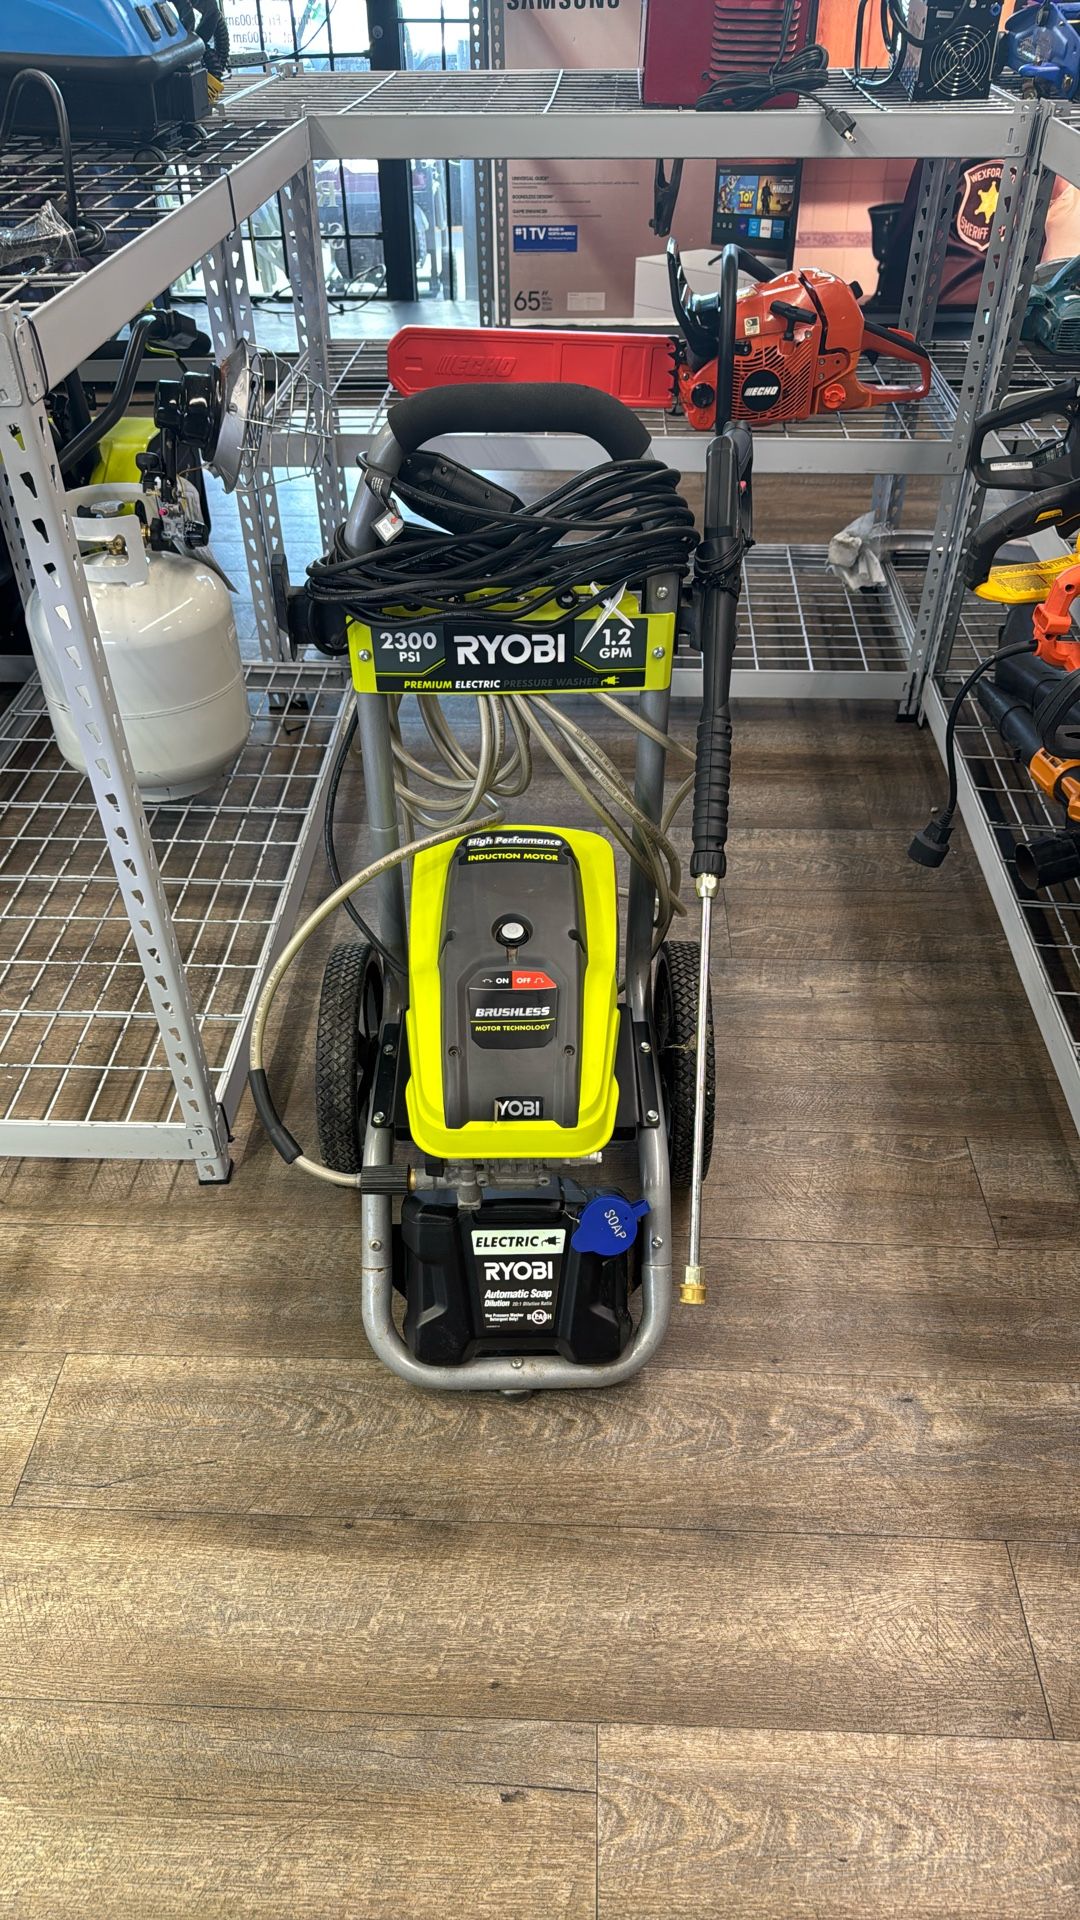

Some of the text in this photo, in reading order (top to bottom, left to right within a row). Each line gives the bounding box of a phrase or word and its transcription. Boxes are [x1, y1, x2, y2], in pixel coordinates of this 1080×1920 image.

[739, 190, 755, 203] TOY
[515, 227, 547, 240] #1 TV
[960, 215, 989, 240] SHERIFF
[450, 356, 517, 377] ECHO
[751, 386, 779, 396] ECHO
[379, 628, 631, 665] 2300 RYOBI 1.2
[399, 646, 633, 663] PSI GPM
[403, 678, 599, 690] PREMIUM ELECTRIC PRESSURE WASHER
[467, 836, 562, 847] High Performance
[467, 852, 558, 862] INDUCTION MOTOR
[475, 1006, 550, 1018] BRUSHLESS
[475, 1023, 550, 1032] MOTOR TECHNOLOGY
[498, 1100, 540, 1116] YOBI
[604, 1209, 627, 1239] SOAP
[475, 1236, 539, 1248] ELECTRIC
[484, 1261, 553, 1280] RYOBI
[484, 1288, 552, 1300] Automatic Soap
[484, 1299, 510, 1307] Dilution
